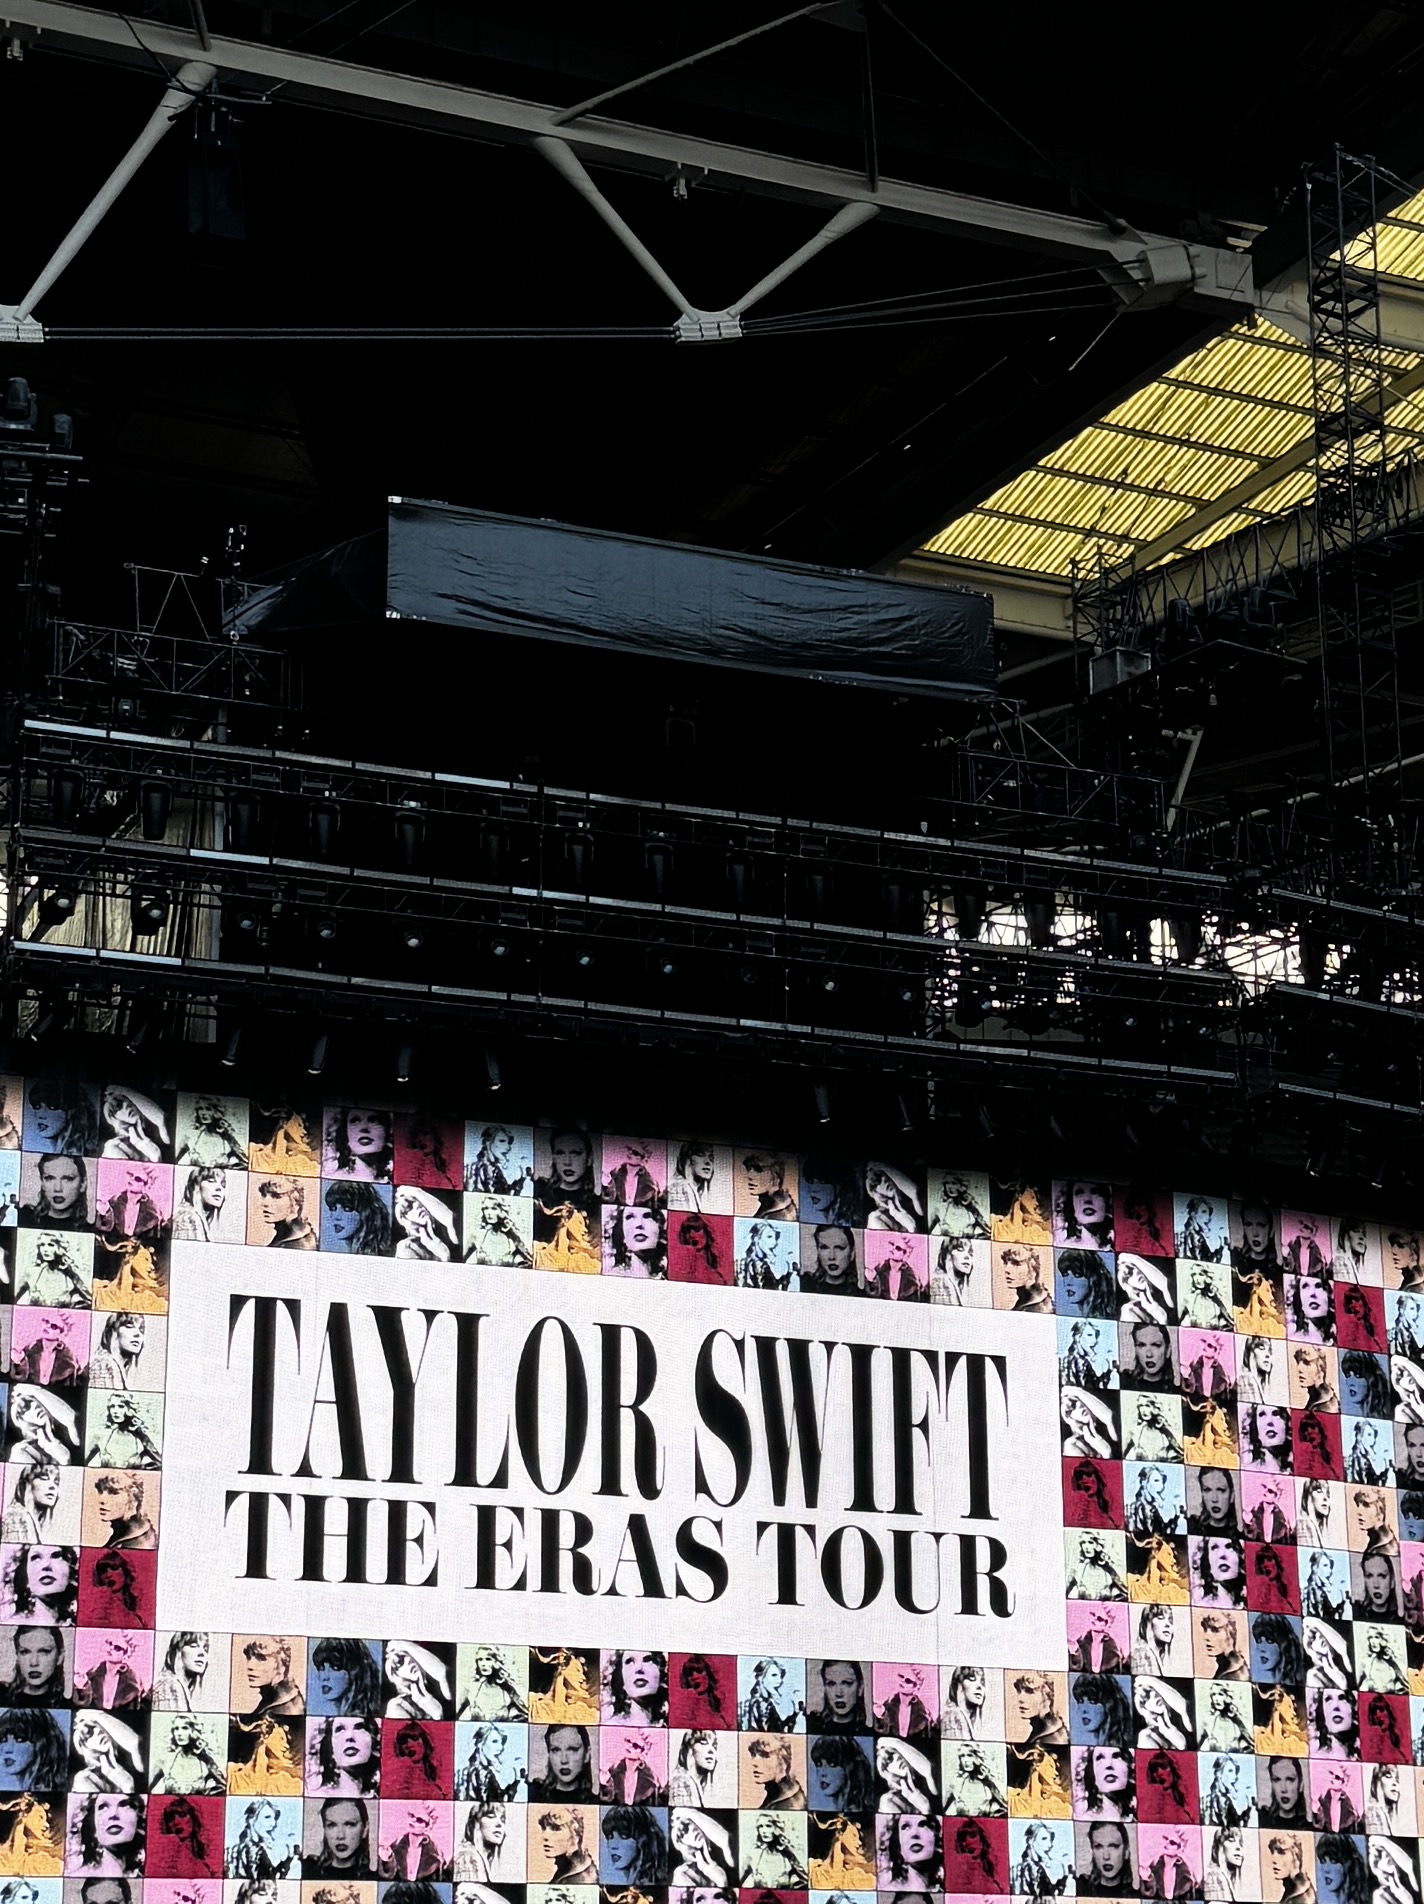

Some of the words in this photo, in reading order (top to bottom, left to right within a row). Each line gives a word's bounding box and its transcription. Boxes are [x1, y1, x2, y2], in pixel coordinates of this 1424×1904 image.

[228, 1294, 666, 1500] TAYLOR
[694, 1328, 1011, 1520] SWIFT
[224, 1490, 440, 1588] THE
[465, 1504, 730, 1603] ERAS
[757, 1521, 1015, 1619] TOUR
